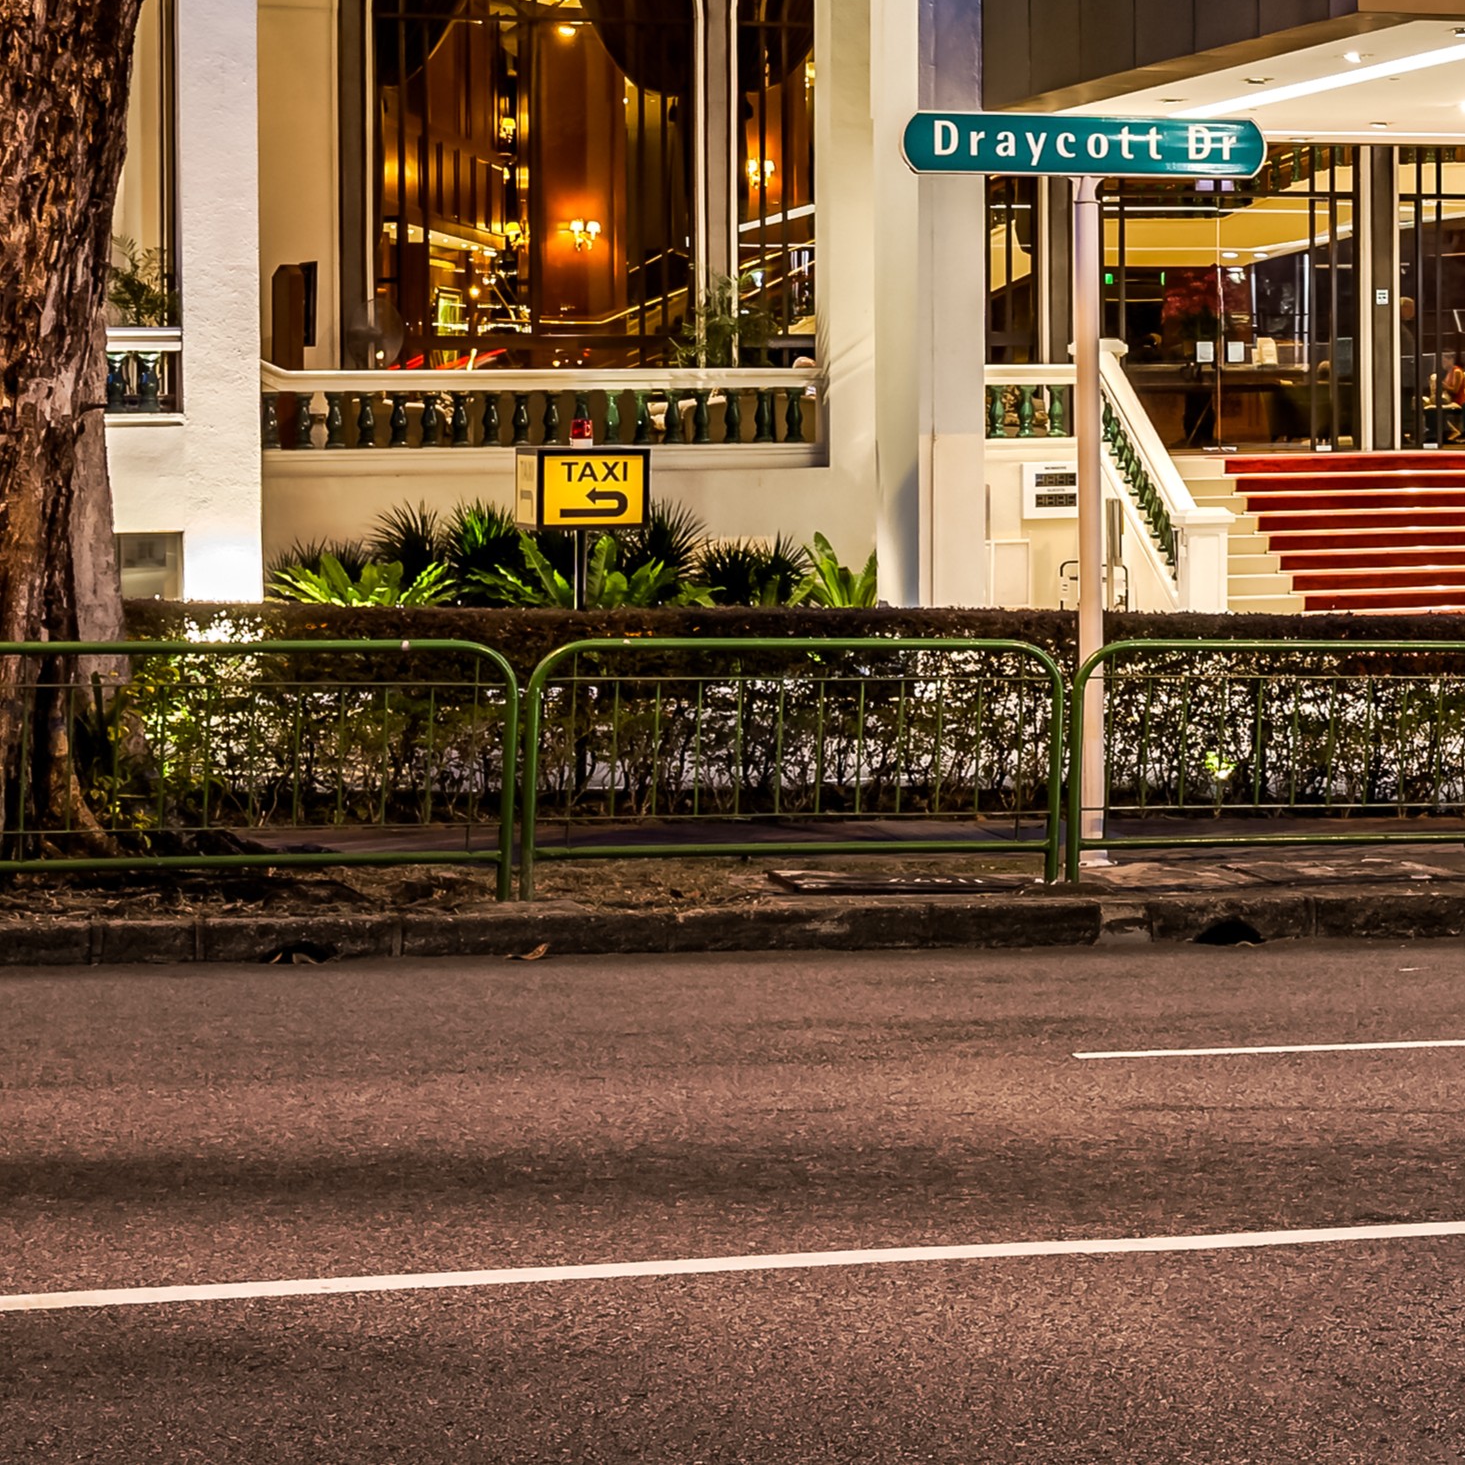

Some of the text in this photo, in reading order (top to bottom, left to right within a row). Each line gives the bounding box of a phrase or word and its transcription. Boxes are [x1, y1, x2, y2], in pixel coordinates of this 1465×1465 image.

[933, 120, 1237, 166] Draycott Dr
[561, 461, 628, 482] TAXI
